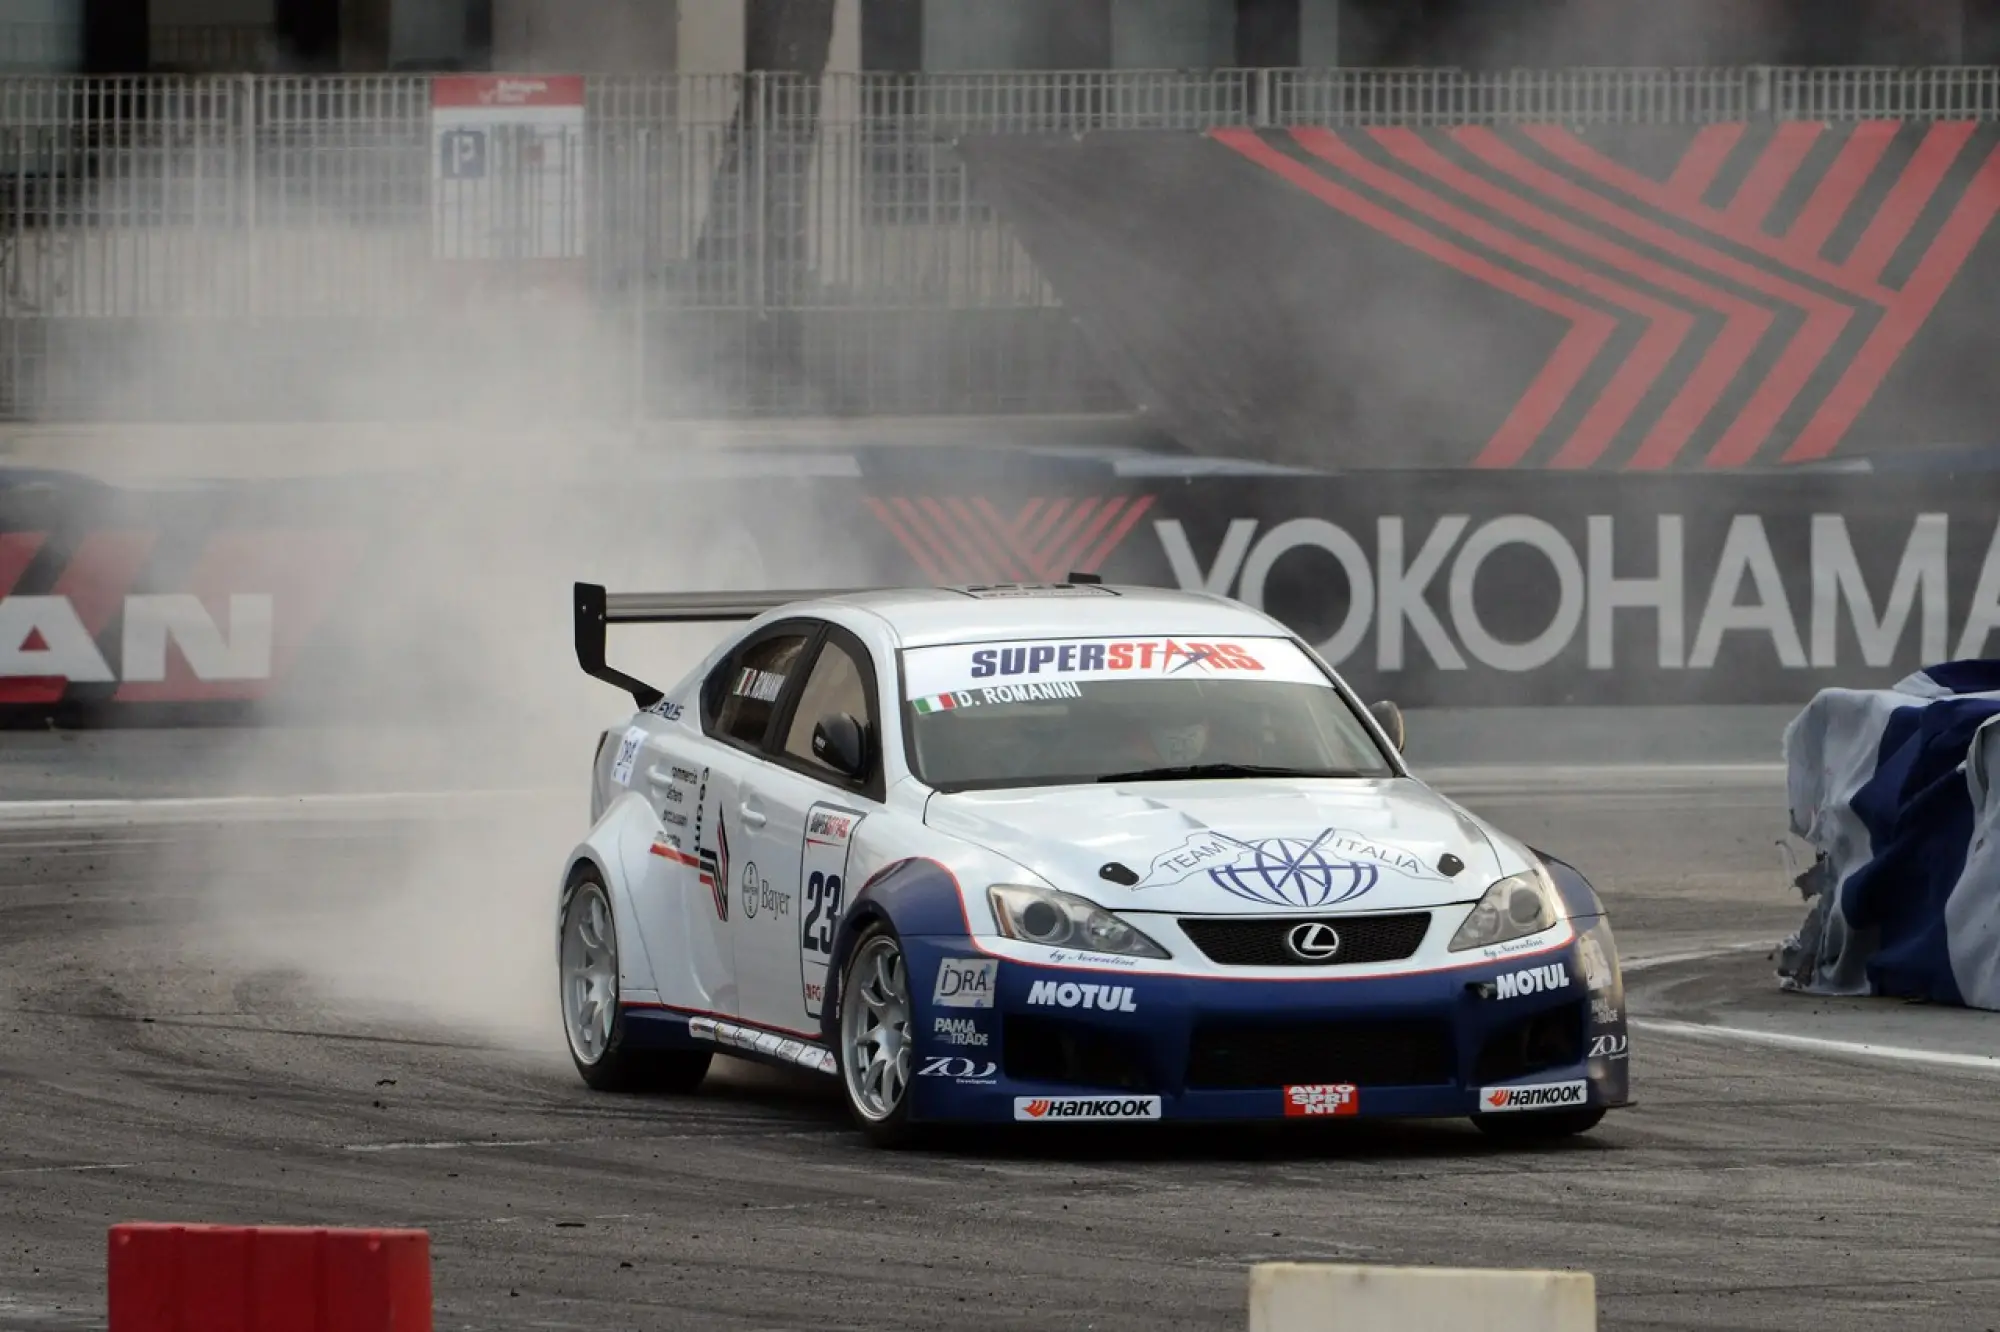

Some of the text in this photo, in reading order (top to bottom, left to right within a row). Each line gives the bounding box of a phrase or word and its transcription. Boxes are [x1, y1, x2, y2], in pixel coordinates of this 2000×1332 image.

[970, 638, 1267, 678] SUPERSTARS
[958, 681, 1083, 708] D. ROMANINI
[1159, 837, 1420, 875] TEAM ITALIA
[761, 879, 791, 920] Bayer
[803, 869, 841, 955] 23
[1027, 980, 1137, 1012] MOTUL
[1496, 962, 1570, 1001] MOTUL
[933, 1017, 976, 1033] PAMA
[951, 1031, 989, 1046] TRADE
[1288, 1085, 1356, 1094] AUTO
[1304, 1103, 1338, 1114] NT
